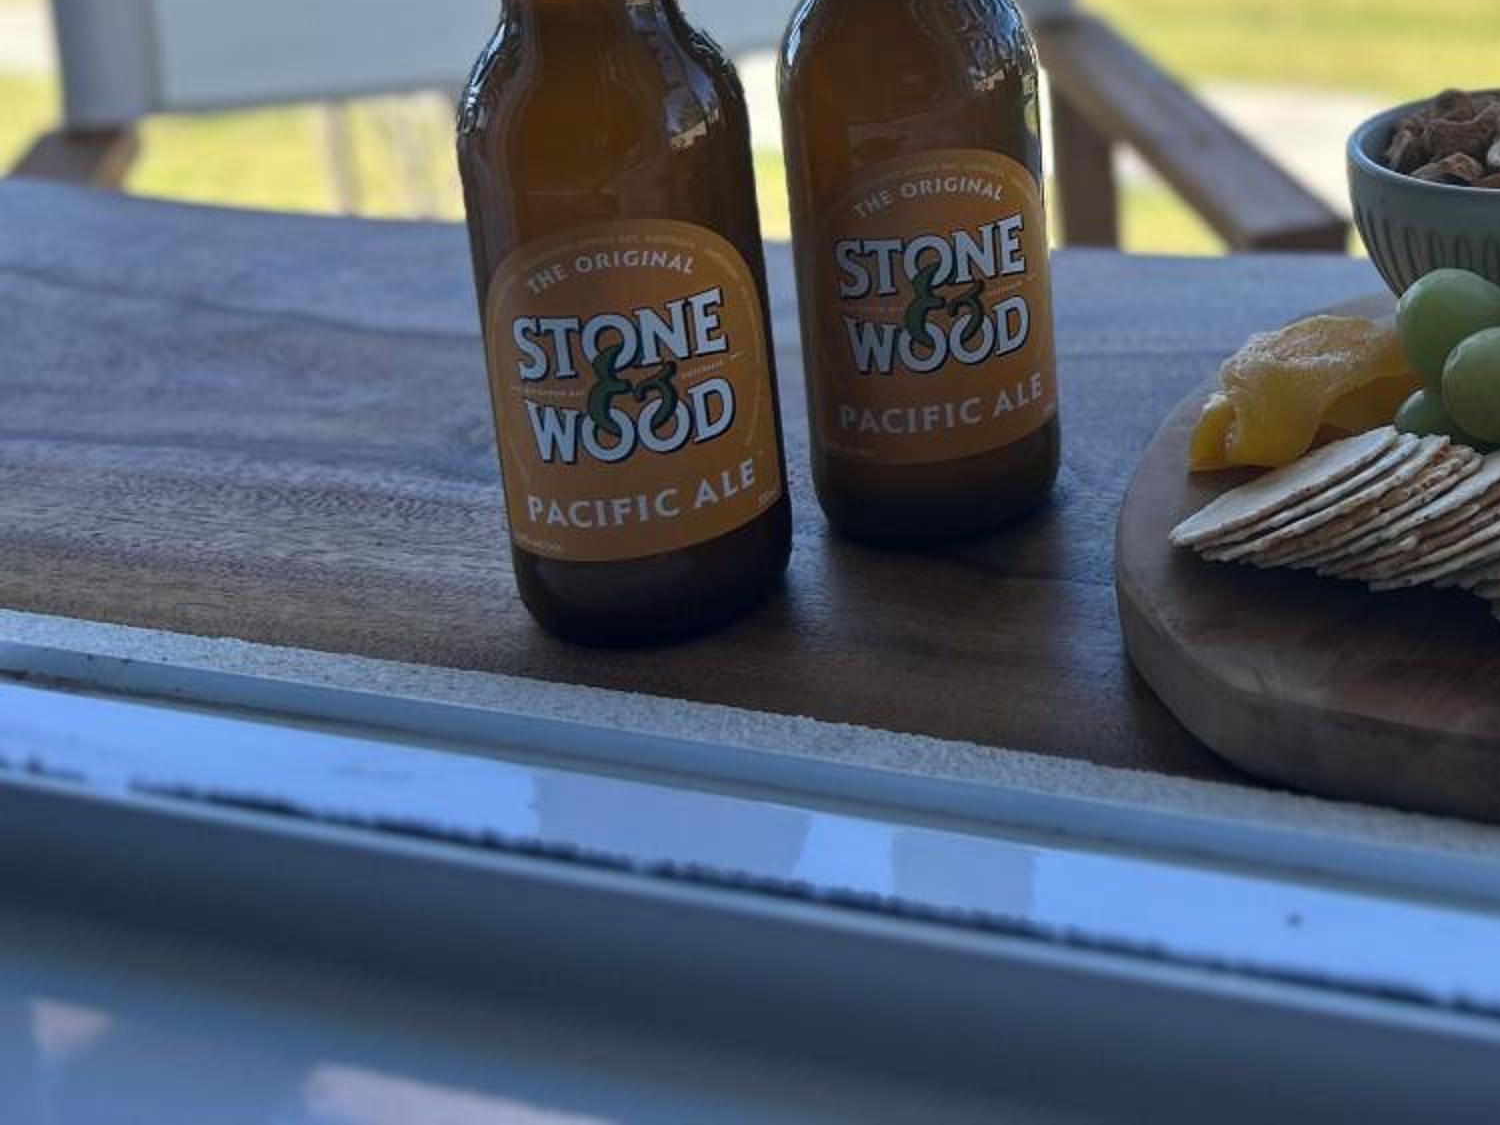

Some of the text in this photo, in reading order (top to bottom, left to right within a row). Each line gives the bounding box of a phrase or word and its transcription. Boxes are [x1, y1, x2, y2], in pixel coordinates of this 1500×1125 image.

[854, 176, 1004, 218] THE ORIGINAL
[526, 250, 694, 296] THE ORIGINAL
[833, 212, 1026, 301] STONE
[511, 286, 730, 381] STONE
[844, 295, 1029, 374] WOOD
[523, 377, 736, 464] WOOD
[839, 372, 1042, 433] PACIFIC ALE
[527, 488, 680, 527] PACIFIC
[694, 459, 756, 509] ALE
